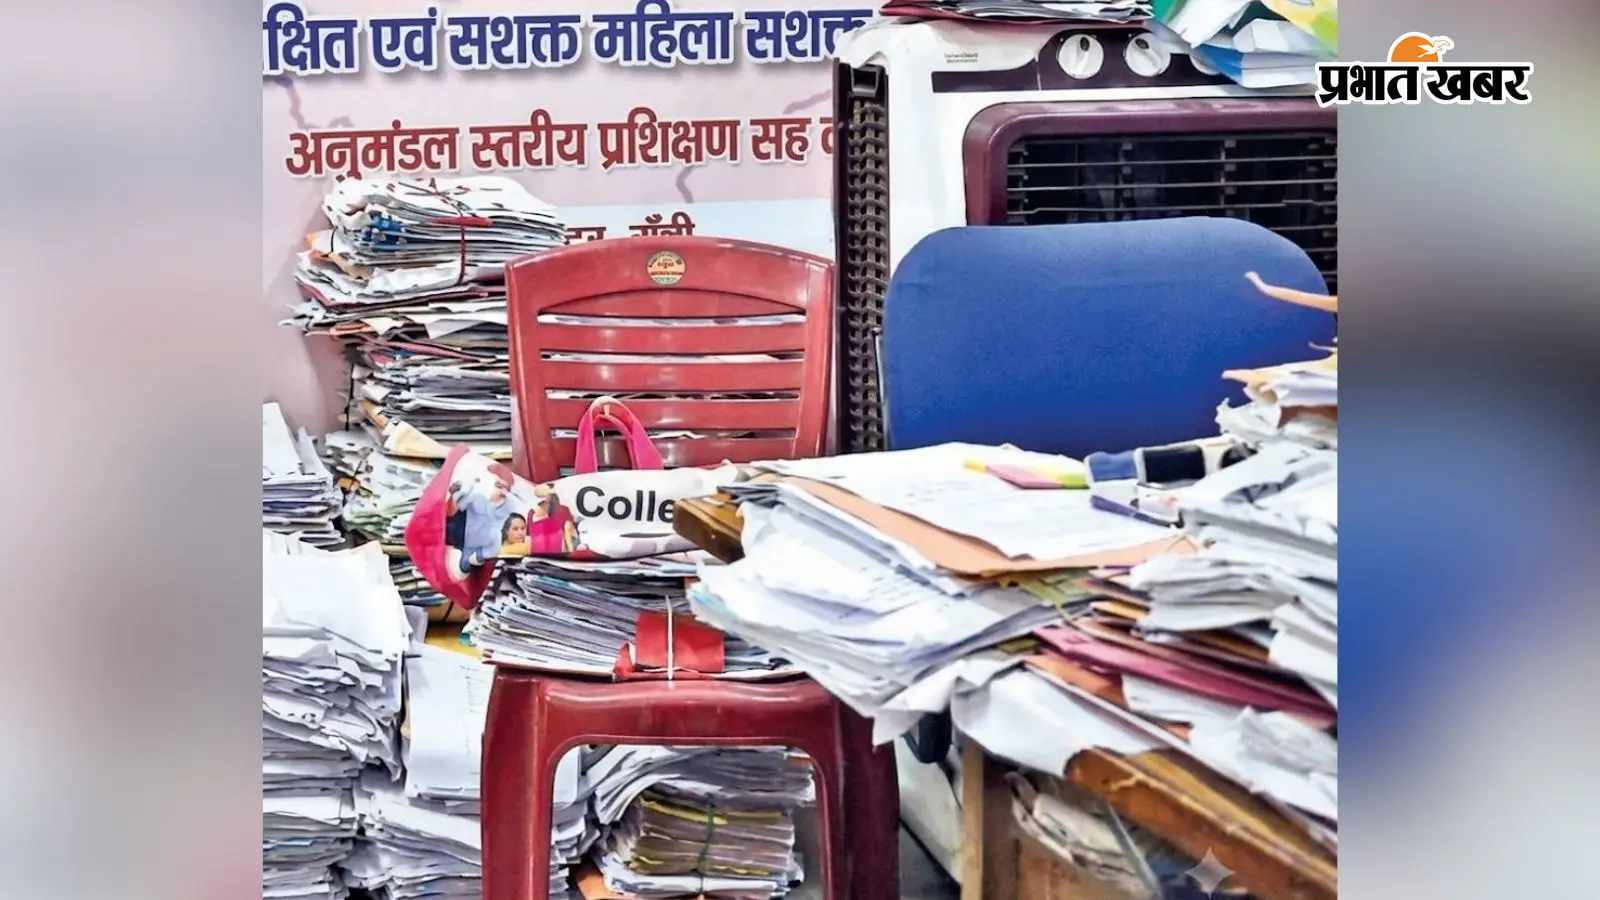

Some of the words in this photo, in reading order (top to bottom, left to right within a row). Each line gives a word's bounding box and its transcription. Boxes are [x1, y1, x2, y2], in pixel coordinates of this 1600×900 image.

[370, 7, 436, 68] एवं
[448, 15, 581, 65] सशक्त
[593, 0, 733, 63] महिला
[286, 119, 459, 180] अनुमंडल
[470, 109, 587, 166] स्तरीय
[598, 107, 740, 169] प्रशिक्षण
[750, 117, 811, 160] सह
